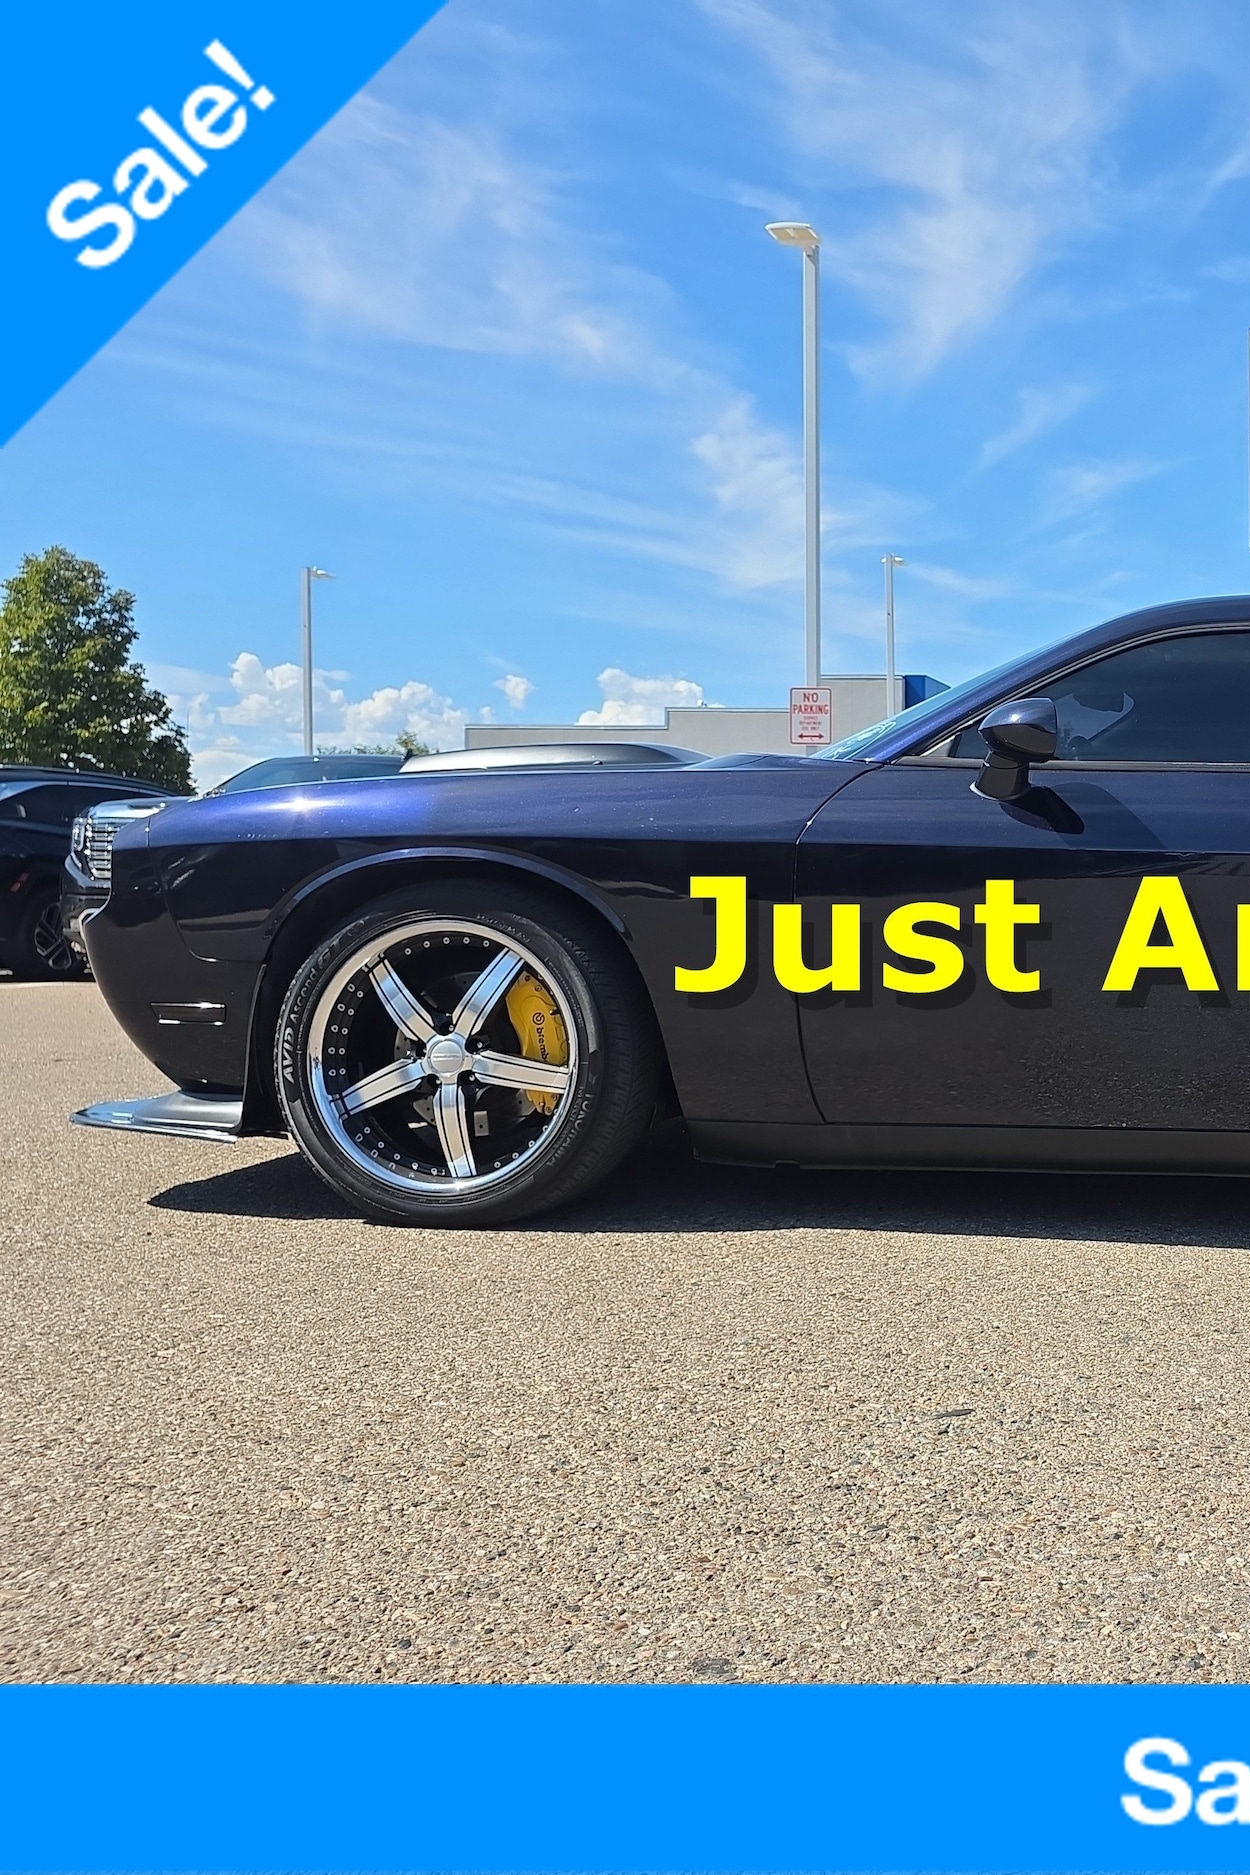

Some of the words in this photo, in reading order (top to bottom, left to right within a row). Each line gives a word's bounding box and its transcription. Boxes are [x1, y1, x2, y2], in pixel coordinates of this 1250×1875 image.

[803, 692, 819, 703] NO
[793, 704, 829, 715] PARKING
[282, 1026, 296, 1085] AVID
[536, 1026, 549, 1062] bremb
